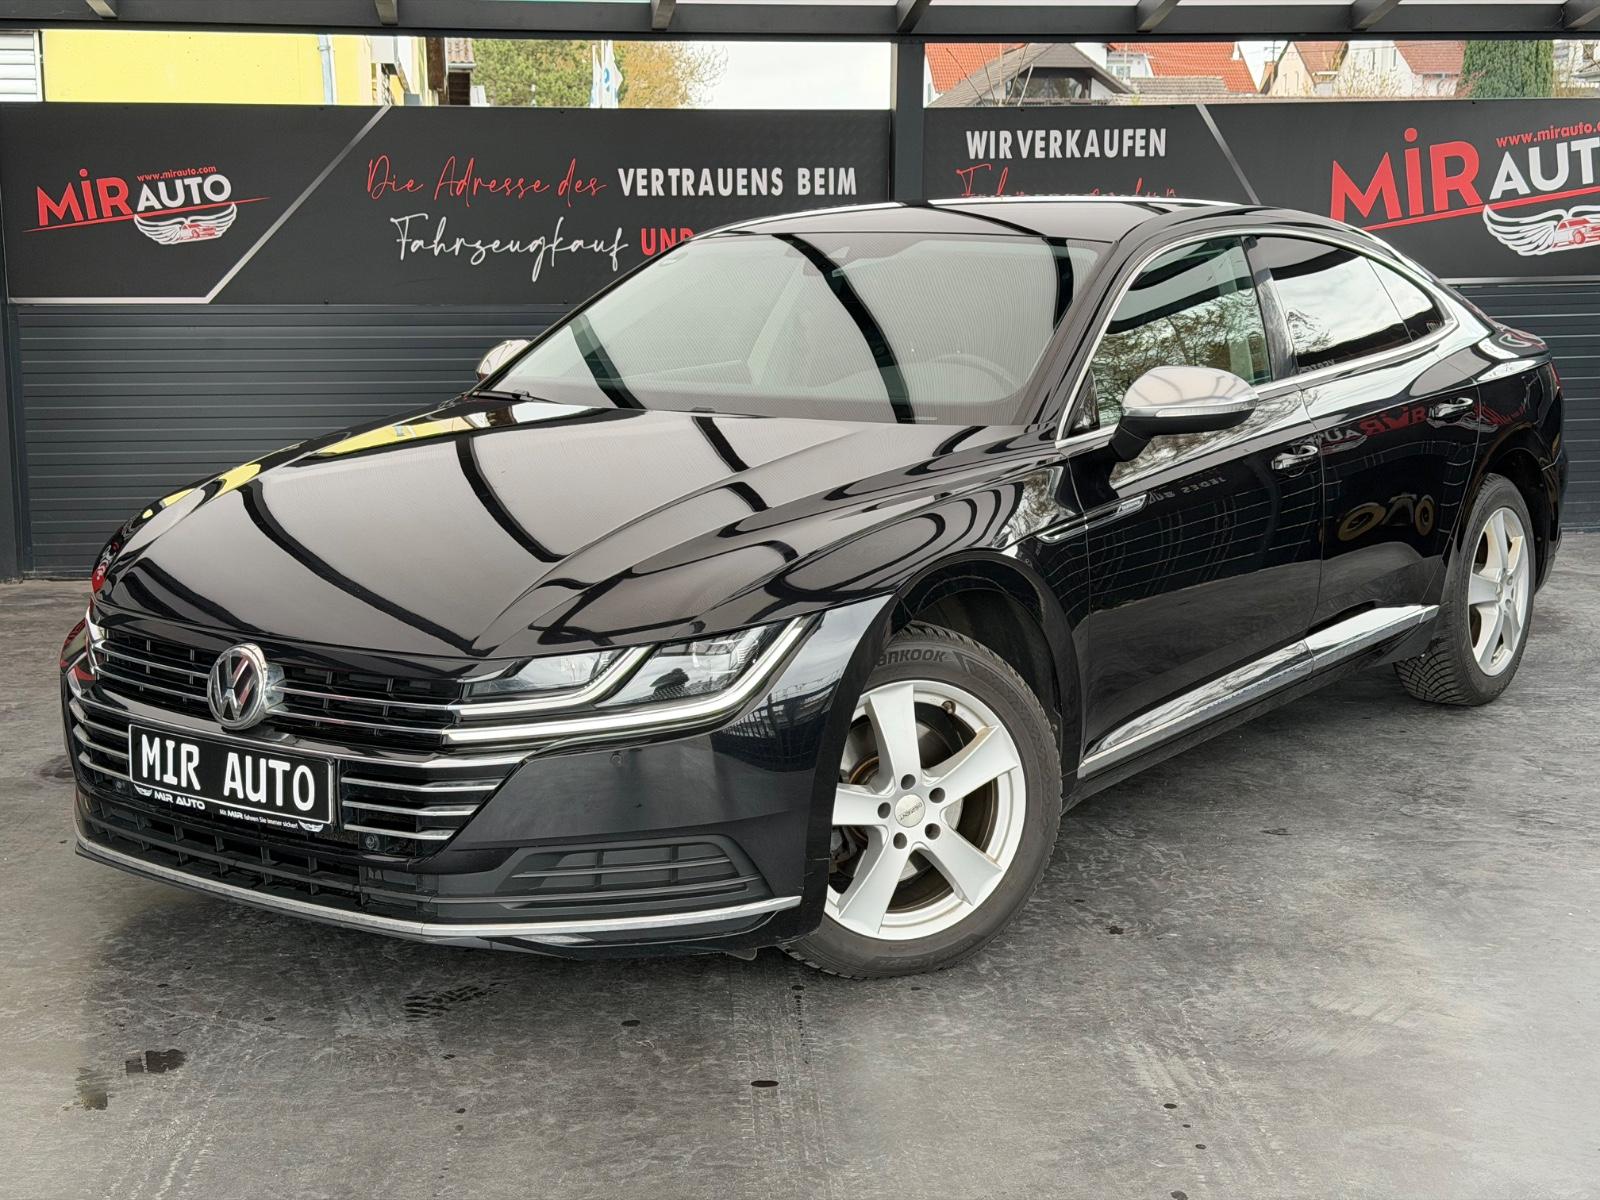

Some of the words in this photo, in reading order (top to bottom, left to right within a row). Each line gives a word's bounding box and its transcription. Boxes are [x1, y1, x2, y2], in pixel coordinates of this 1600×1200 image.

[136, 165, 217, 182] www.mirauto.com
[136, 174, 232, 212] AUTO
[367, 155, 424, 200] Die
[434, 155, 551, 207] Adresse
[558, 158, 608, 207] des
[617, 167, 784, 197] VERTRAUENS
[797, 167, 857, 195] BEIM
[390, 213, 629, 282] Fahrzeugkauf
[141, 734, 201, 791] MIR
[223, 752, 315, 811] AUTO
[154, 791, 174, 803] MIR
[176, 796, 206, 810] AUTO
